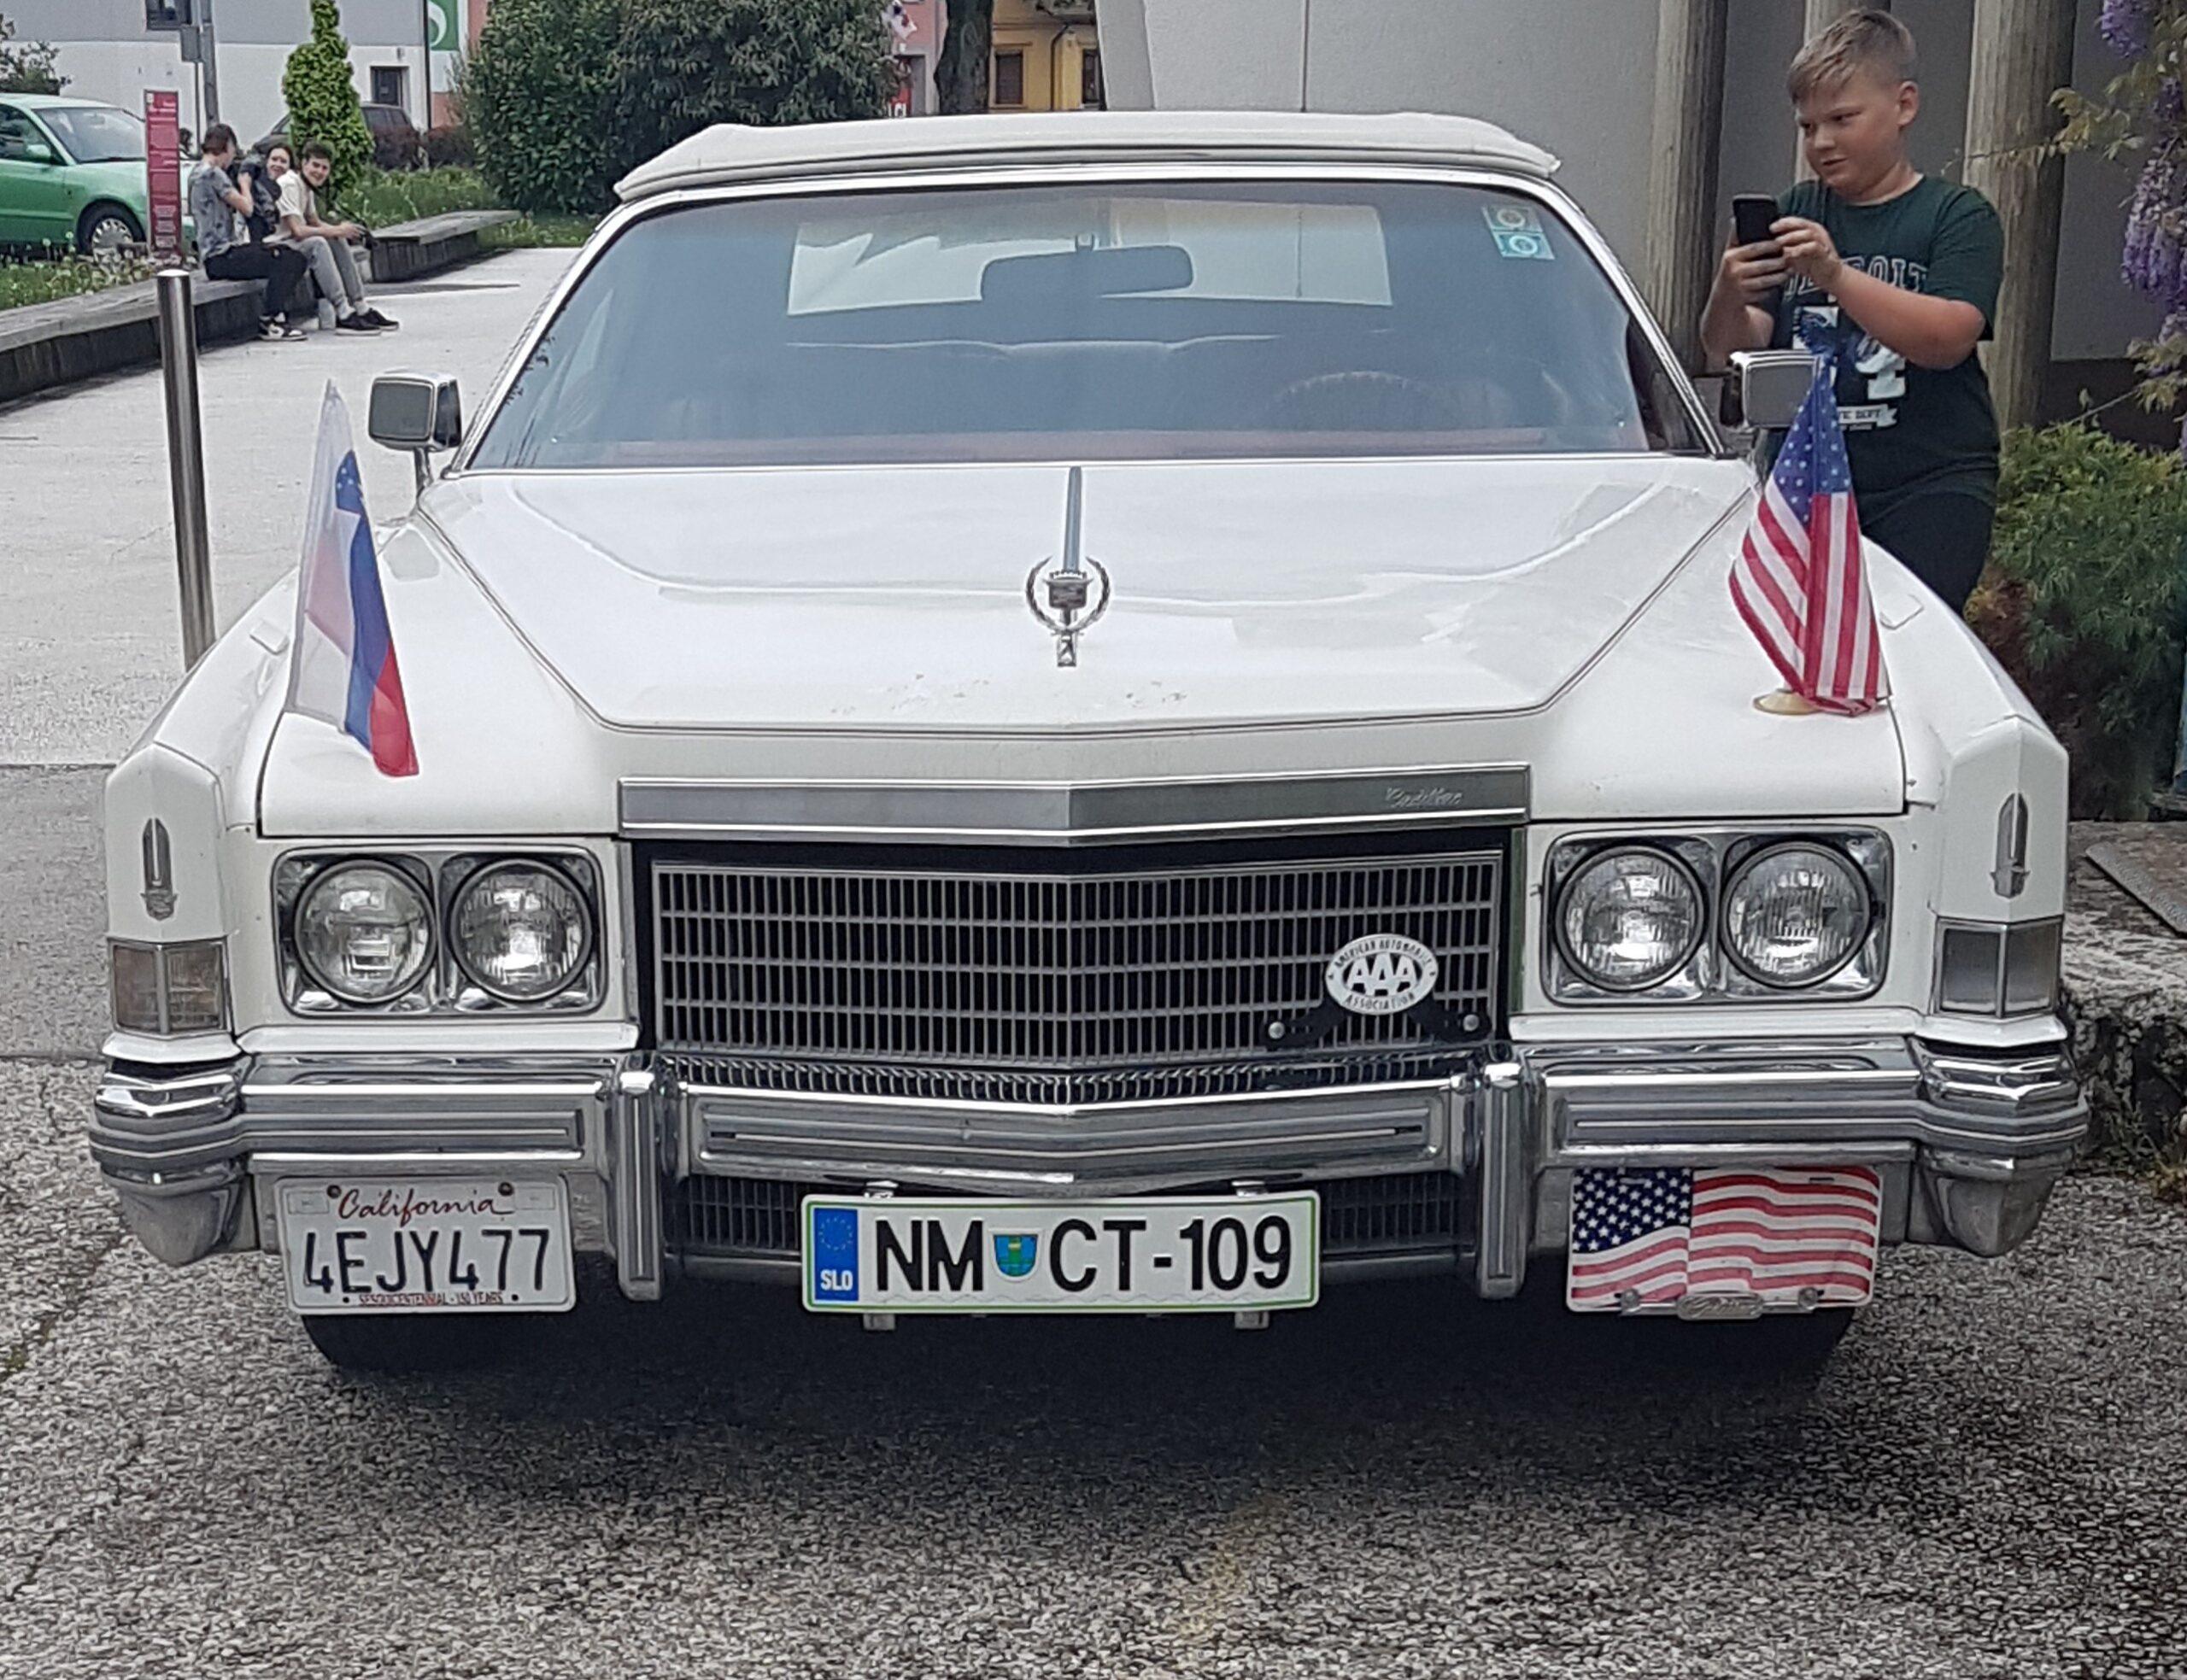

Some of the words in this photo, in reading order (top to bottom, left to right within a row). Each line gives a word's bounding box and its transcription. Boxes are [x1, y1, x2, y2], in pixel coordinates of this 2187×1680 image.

[1334, 940, 1376, 968] AMERICAN
[1346, 951, 1418, 998] AAA
[1346, 992, 1415, 1010] ASSOCIATION
[338, 1188, 515, 1227] California
[303, 1228, 550, 1294] 4EJY477
[875, 1219, 983, 1291] NM
[1049, 1215, 1292, 1292] CT-109
[820, 1269, 853, 1291] SLO
[473, 1291, 504, 1306] YEARS
